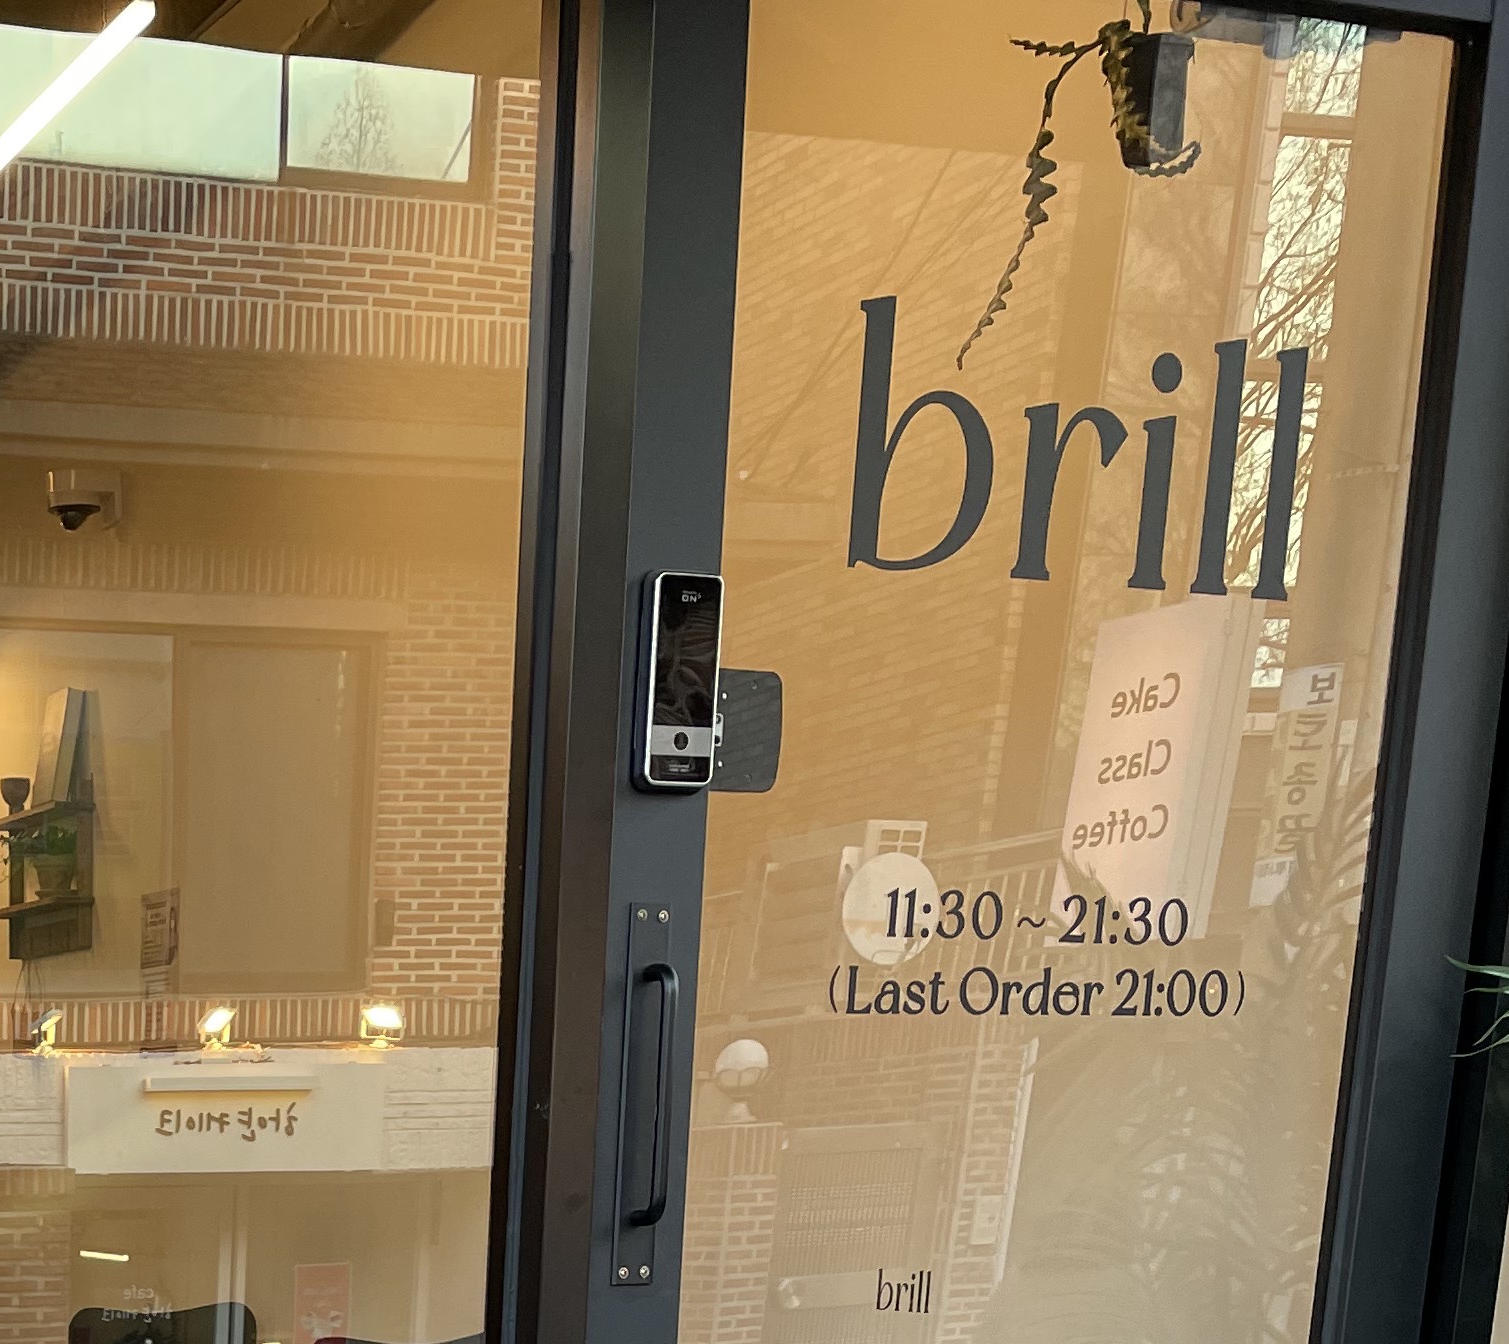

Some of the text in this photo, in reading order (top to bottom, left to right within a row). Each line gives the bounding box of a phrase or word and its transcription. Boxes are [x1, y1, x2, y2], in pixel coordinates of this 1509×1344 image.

[848, 295, 1309, 601] brill
[886, 887, 1003, 941] 11:30
[1058, 894, 1190, 947] 21:30
[829, 964, 1246, 1018] (Last Order 21:00)
[876, 1268, 931, 1313] brill
